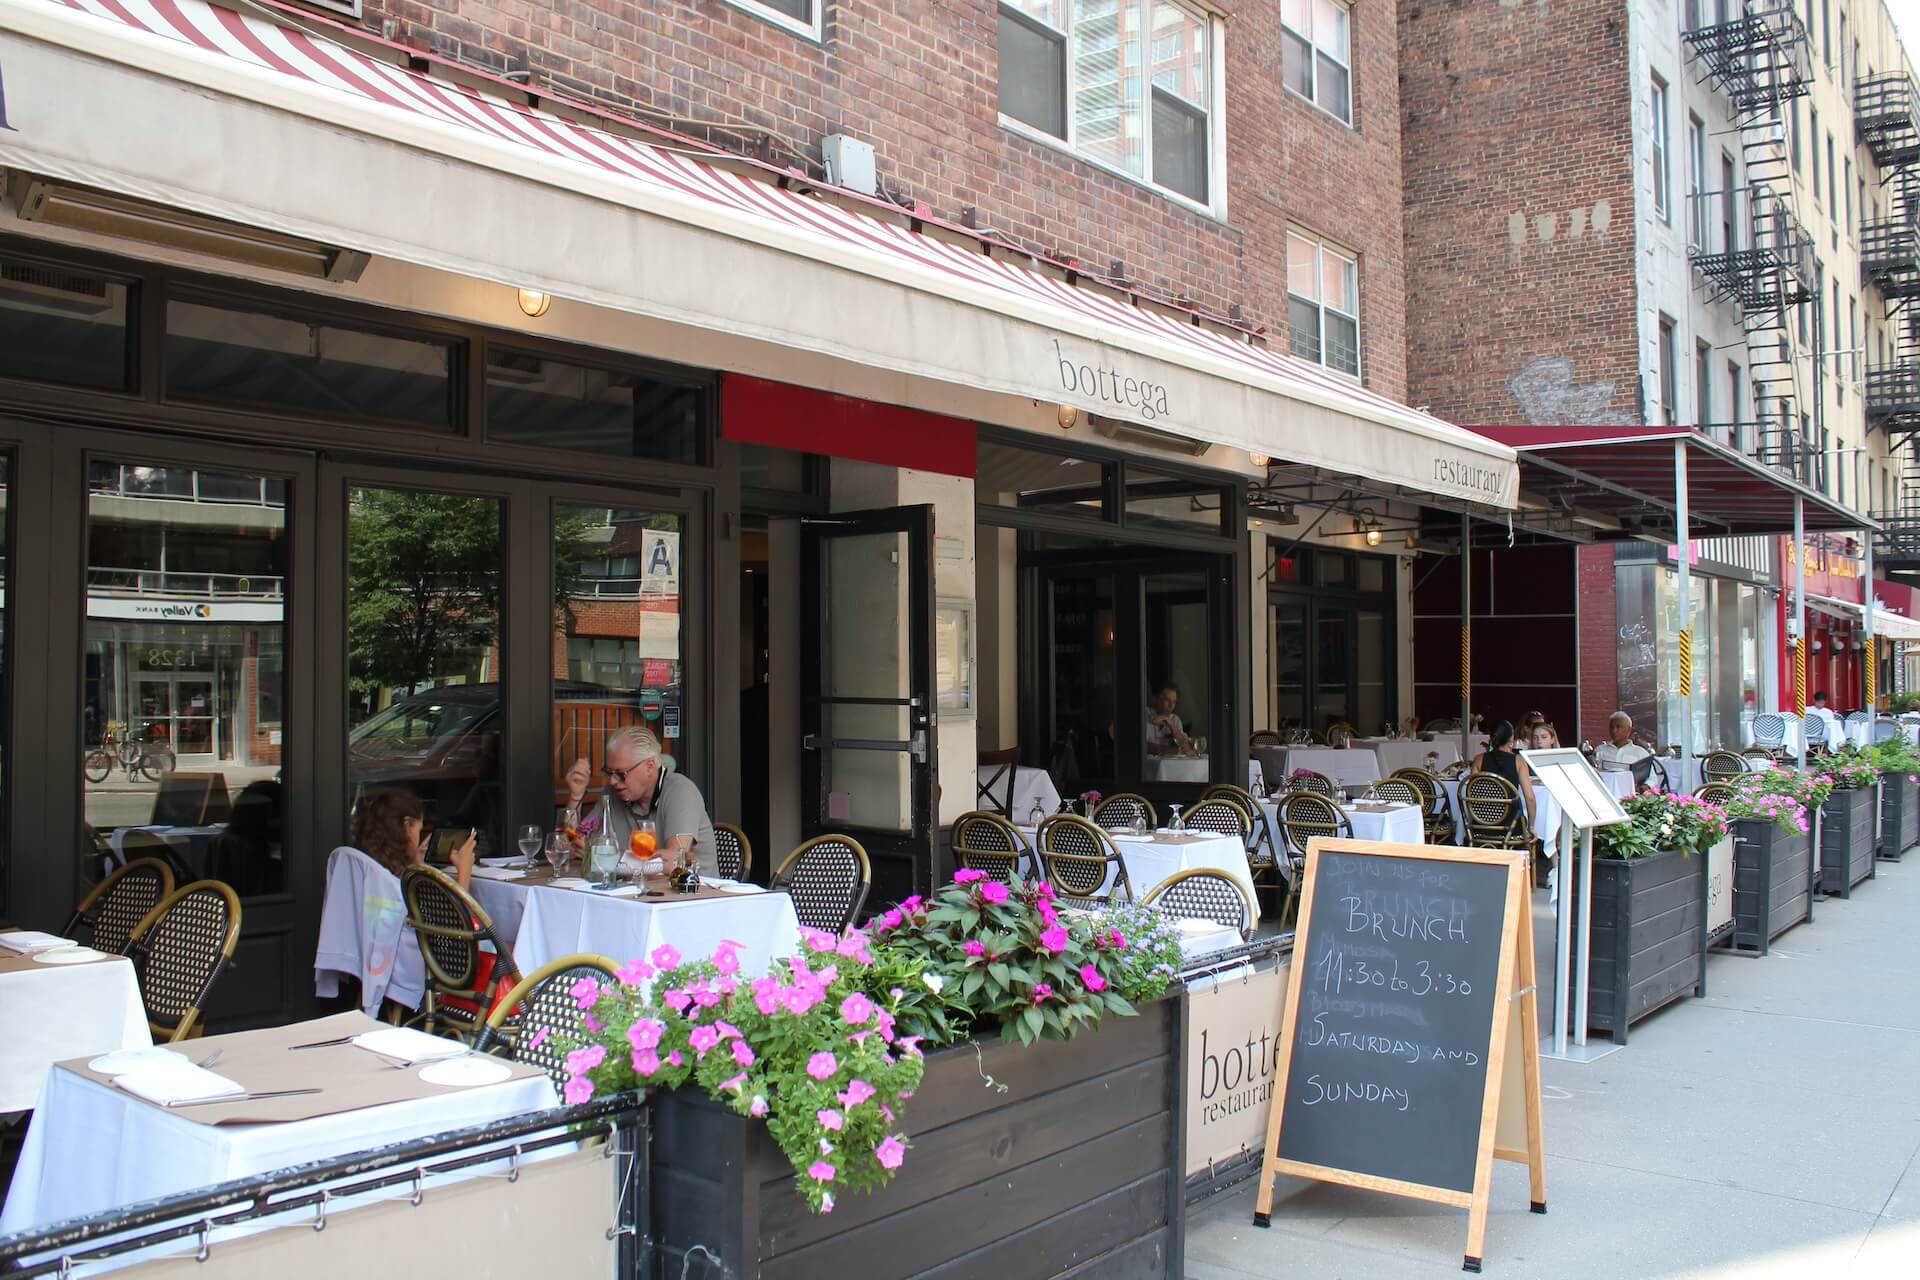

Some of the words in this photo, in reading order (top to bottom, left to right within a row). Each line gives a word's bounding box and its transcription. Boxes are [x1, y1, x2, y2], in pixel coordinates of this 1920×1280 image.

[1052, 338, 1170, 420] bottega
[1433, 457, 1501, 494] restaurant
[648, 538, 673, 576] A
[1319, 949, 1385, 994] 11:30
[1391, 960, 1409, 991] to
[1413, 960, 1472, 996] 3:30
[1200, 1024, 1282, 1101] botte
[1432, 1047, 1479, 1066] AND
[1202, 1080, 1276, 1126] restauran
